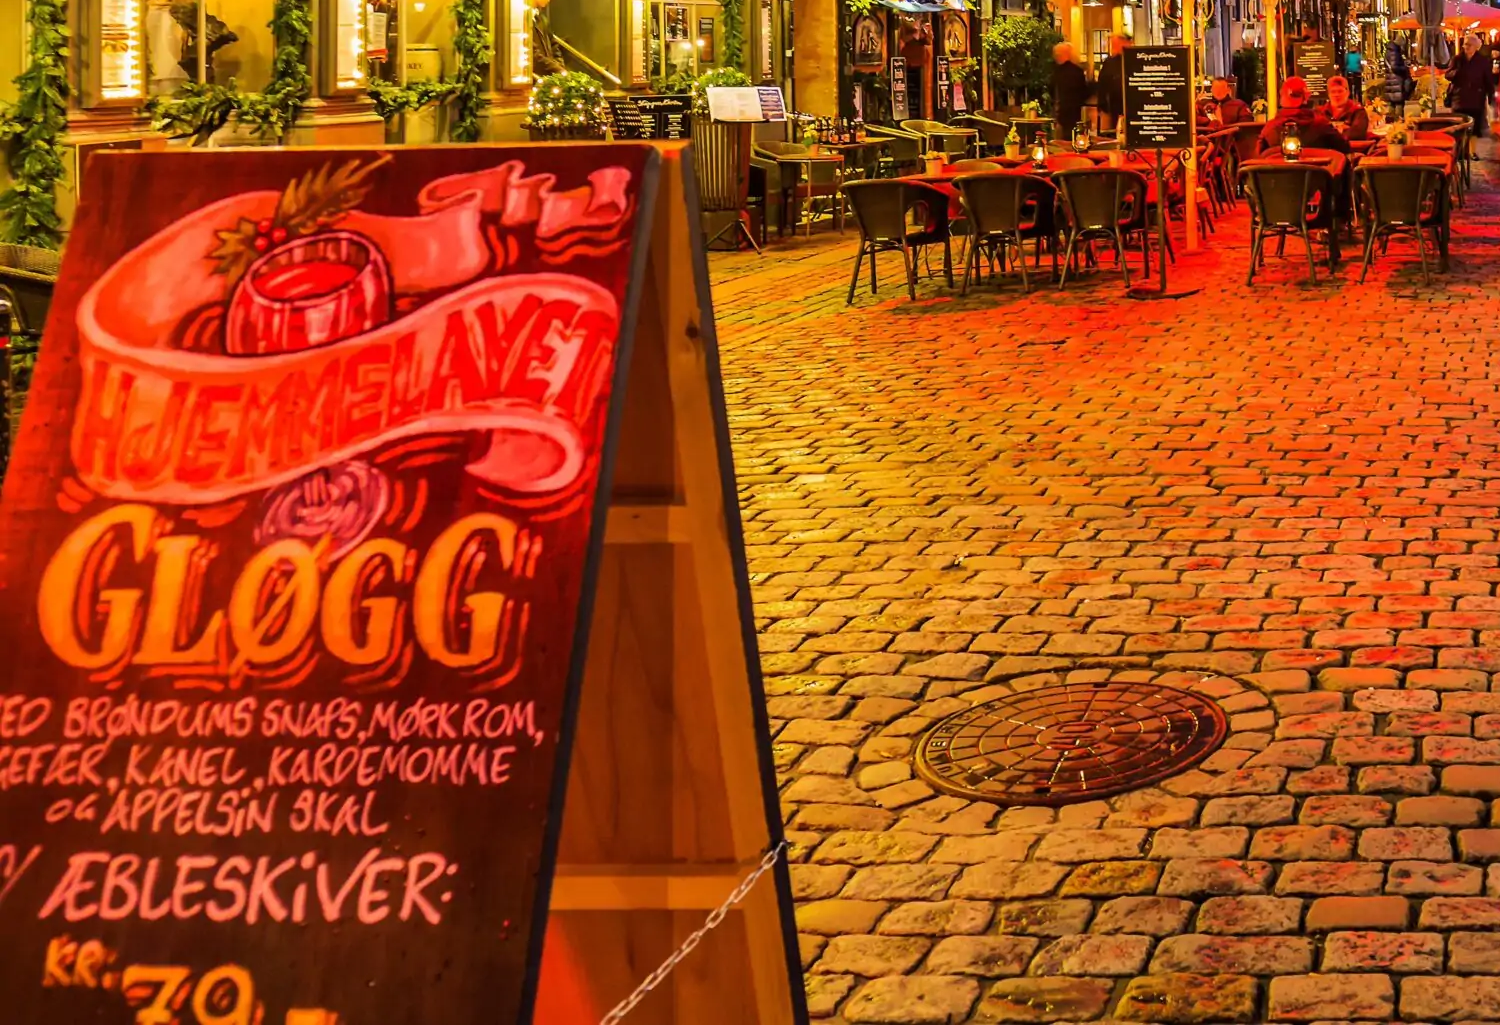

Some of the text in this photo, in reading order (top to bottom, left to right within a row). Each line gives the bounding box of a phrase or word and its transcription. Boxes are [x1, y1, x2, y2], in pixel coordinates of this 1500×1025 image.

[38, 503, 518, 685] GLØGG
[0, 695, 51, 739] ED
[64, 693, 257, 747] BRØNDUMS
[268, 742, 517, 787] KARDEMOMME
